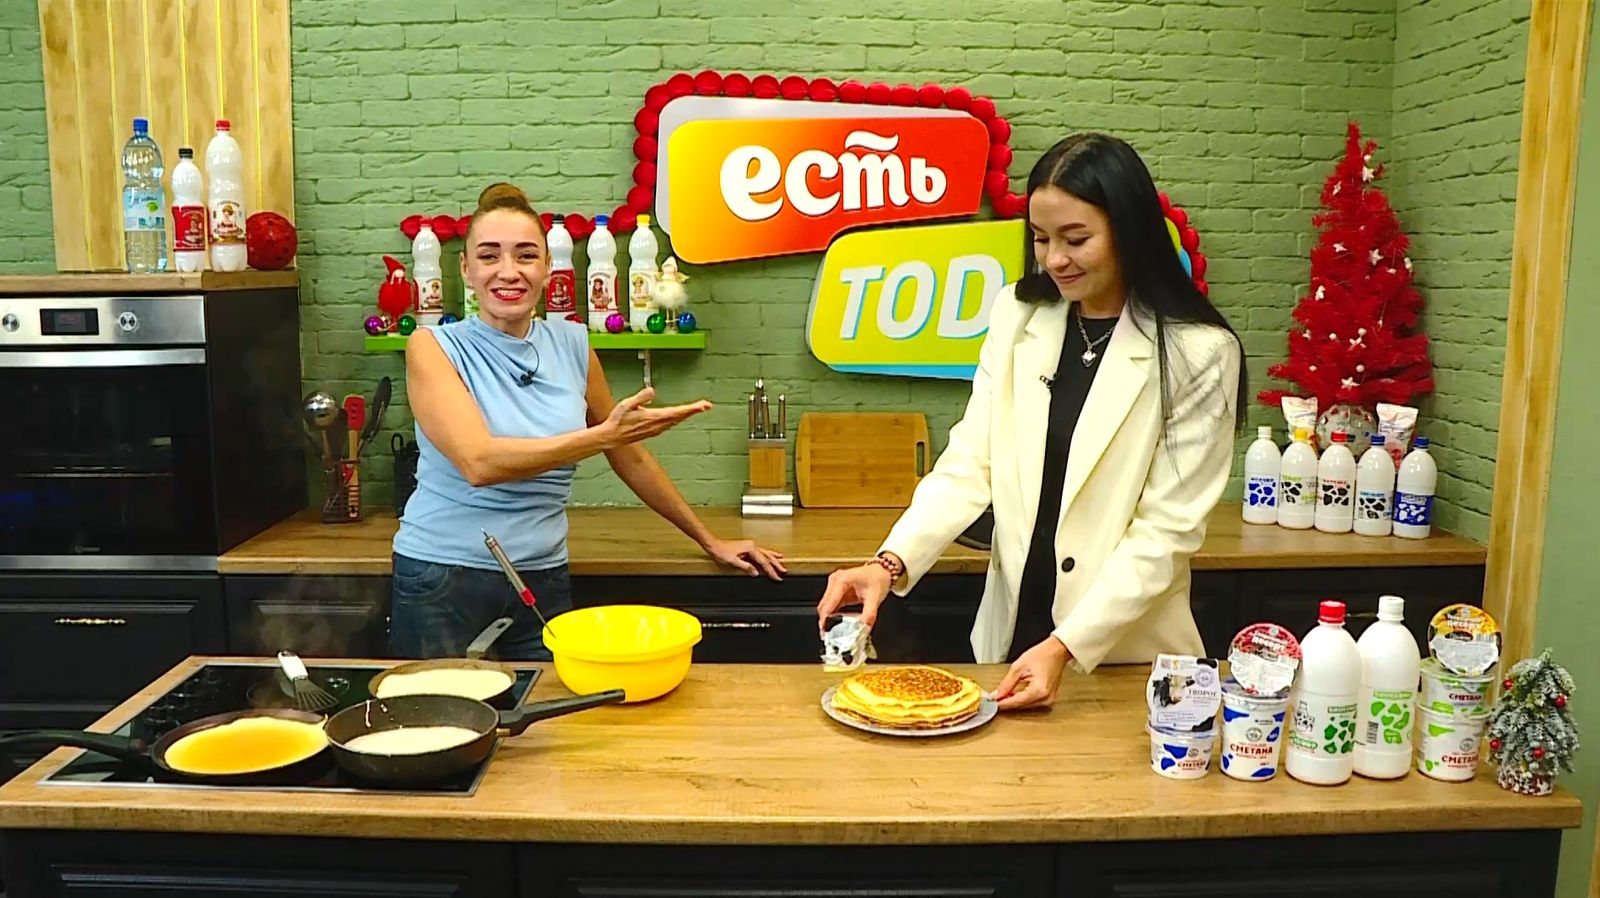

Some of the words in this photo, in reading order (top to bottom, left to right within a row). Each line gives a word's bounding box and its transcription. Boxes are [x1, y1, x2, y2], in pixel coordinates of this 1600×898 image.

[720, 130, 947, 221] есть
[837, 252, 1005, 341] TOD
[1230, 743, 1273, 755] СМЕТАНА
